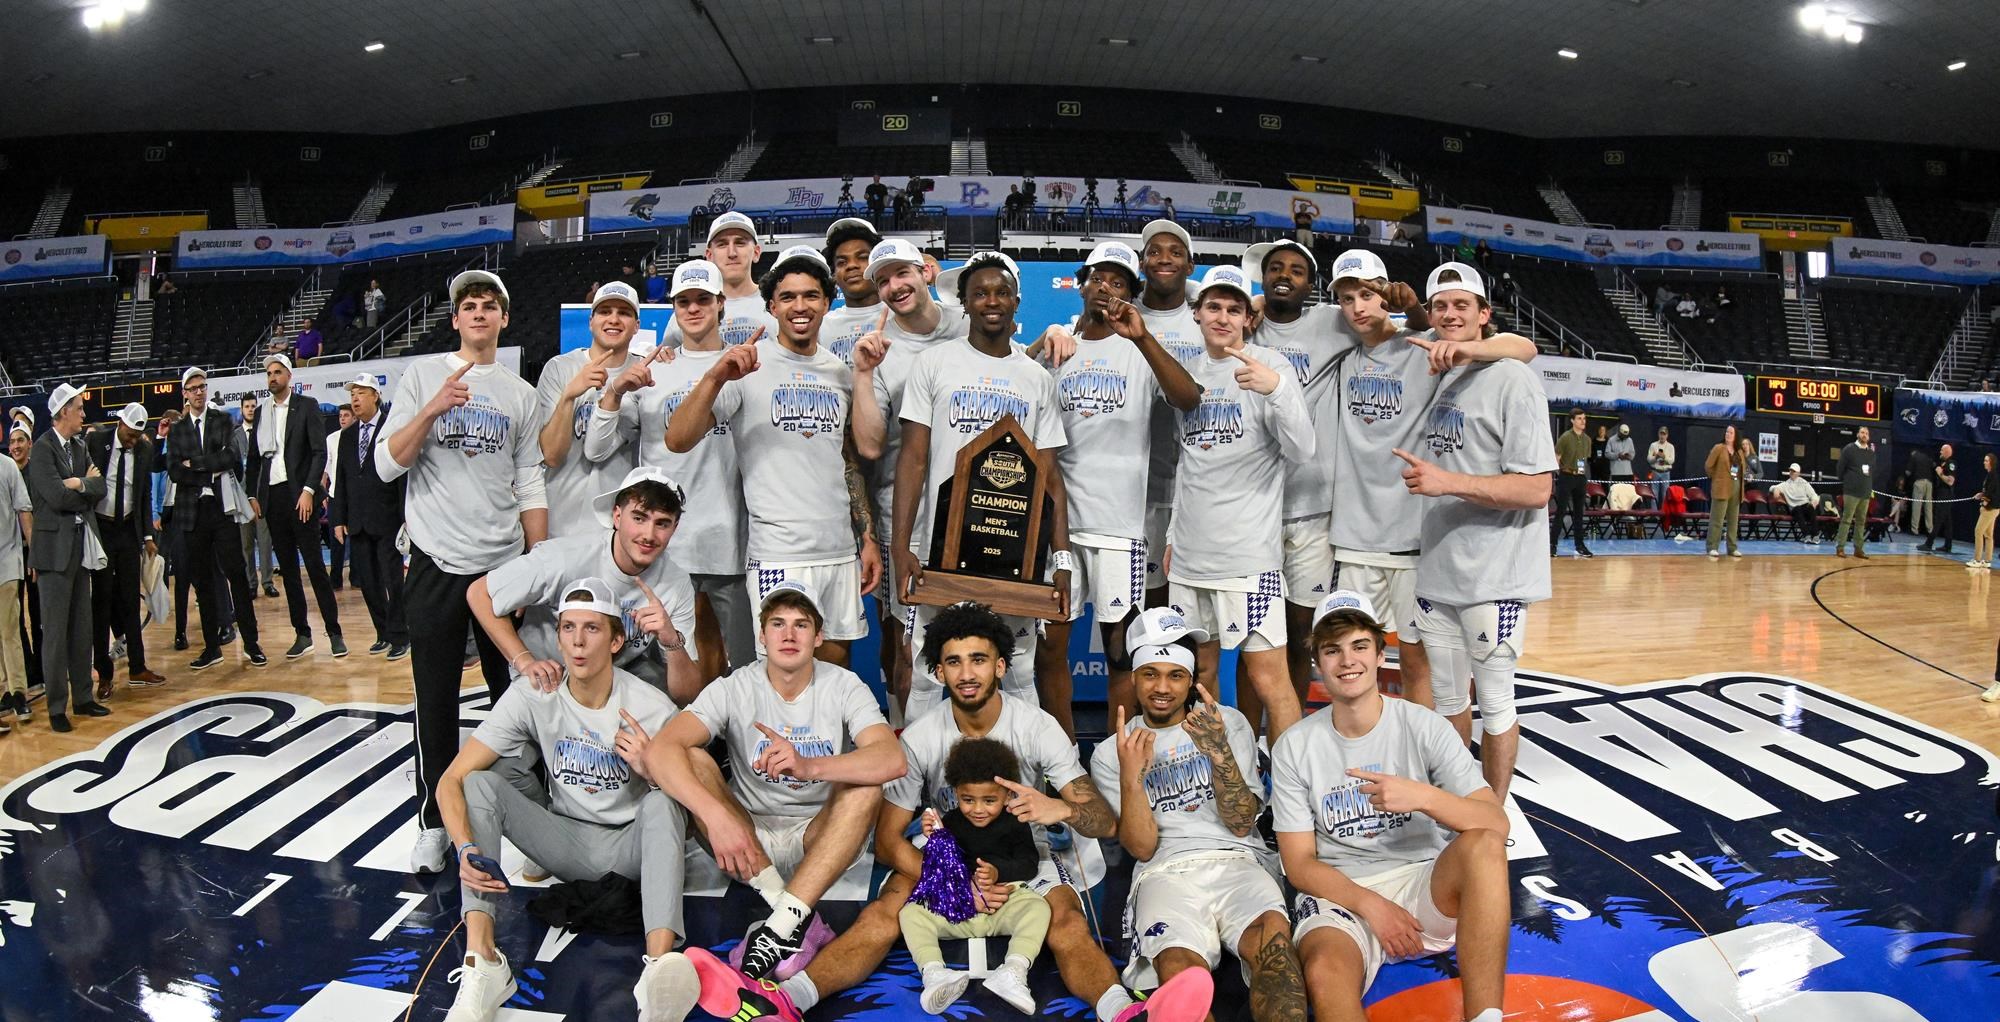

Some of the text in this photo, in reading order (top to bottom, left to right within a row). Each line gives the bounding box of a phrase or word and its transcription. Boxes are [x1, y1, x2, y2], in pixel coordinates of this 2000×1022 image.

[1061, 103, 1077, 114] 21
[654, 114, 669, 126] 19
[886, 116, 905, 129] 20
[1262, 116, 1279, 127] 22
[1445, 140, 1460, 150] 23
[1607, 152, 1622, 162] 23
[1772, 154, 1786, 164] 24
[785, 186, 823, 209] HPU
[1208, 198, 1246, 210] Upstate
[255, 388, 271, 399] TIRES
[1681, 386, 1730, 398] HERCULES TIRES
[1768, 379, 1787, 389] HPU
[1799, 381, 1838, 398] 60:00
[771, 388, 841, 429] CHAMPIONS
[1102, 404, 1115, 414] 25
[1774, 392, 1875, 415] 0 0
[1802, 402, 1821, 410] PERIOD
[1379, 411, 1393, 420] 25
[713, 426, 727, 435] 25
[783, 422, 832, 433] 20 25
[960, 424, 972, 433] 20
[1219, 434, 1233, 444] 25
[447, 440, 496, 454] 20 25
[1443, 443, 1454, 453] 25
[980, 466, 1026, 483] CHAMPIONSHIPS
[971, 494, 1027, 511] CHAMPION
[985, 517, 1008, 527] MEN'S
[970, 525, 1019, 538] BASKETBALL
[983, 547, 1001, 555] 2025
[553, 740, 630, 785] CHAMPIONS
[563, 775, 620, 790] 20 25
[1331, 782, 1352, 792] MEN'S
[1160, 801, 1176, 813] 20
[1338, 817, 1404, 838] 20 25
